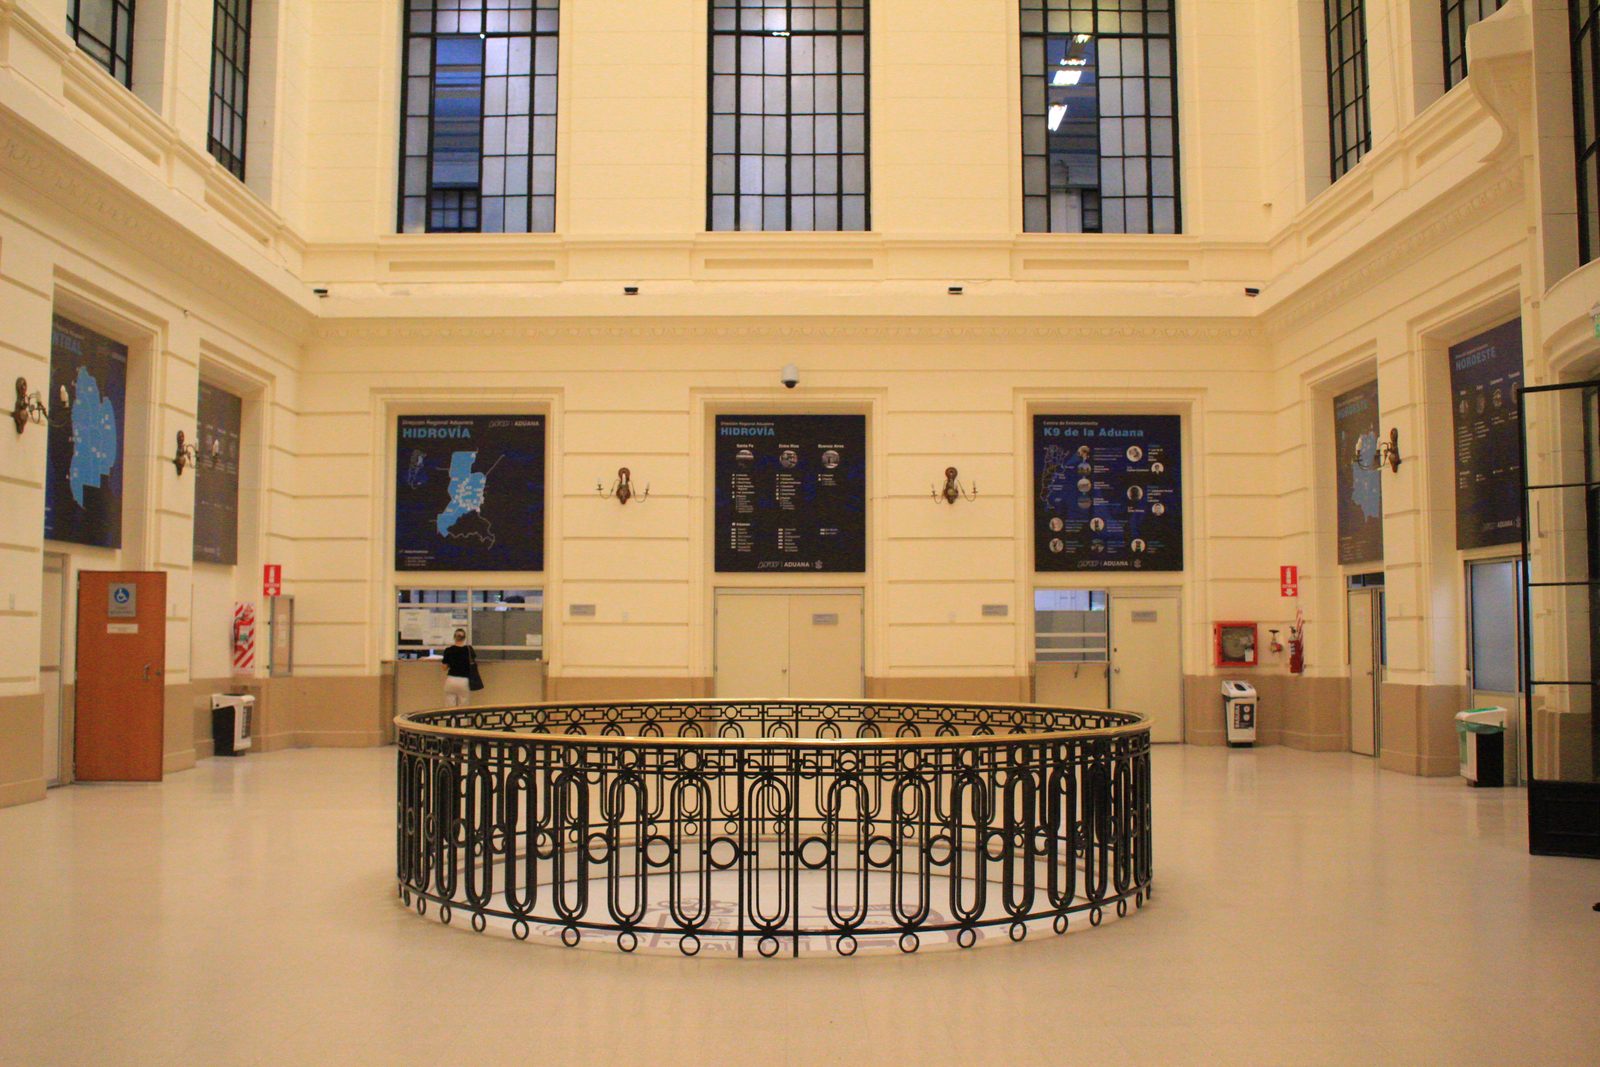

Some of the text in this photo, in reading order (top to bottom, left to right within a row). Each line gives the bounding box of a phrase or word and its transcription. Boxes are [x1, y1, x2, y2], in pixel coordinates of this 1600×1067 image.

[1455, 346, 1496, 371] NOROESTE
[402, 426, 471, 439] HIDROVÍA
[720, 426, 775, 436] HIDROVÍA
[1043, 427, 1144, 437] K9 de la Aduana
